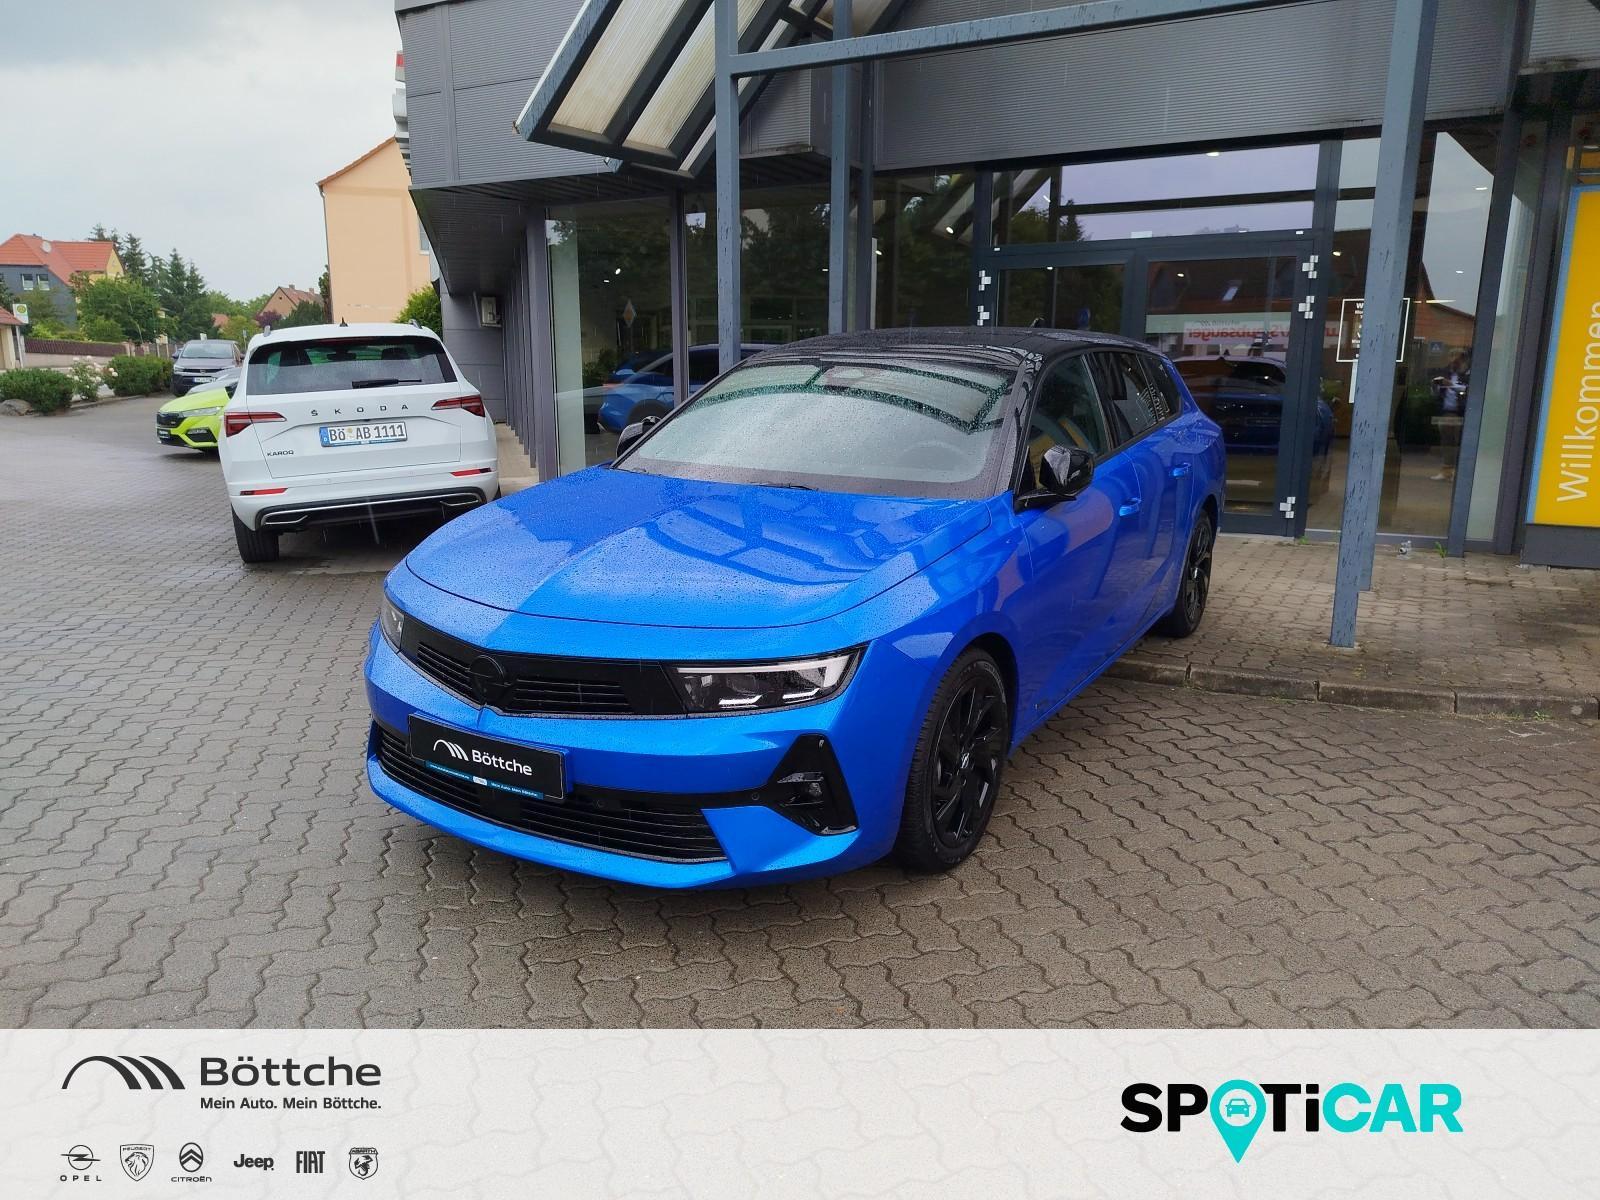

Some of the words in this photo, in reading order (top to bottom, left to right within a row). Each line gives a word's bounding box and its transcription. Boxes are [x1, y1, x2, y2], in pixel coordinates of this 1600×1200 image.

[356, 426, 372, 440] AB
[374, 424, 405, 439] 1111
[471, 749, 533, 776] Böttche
